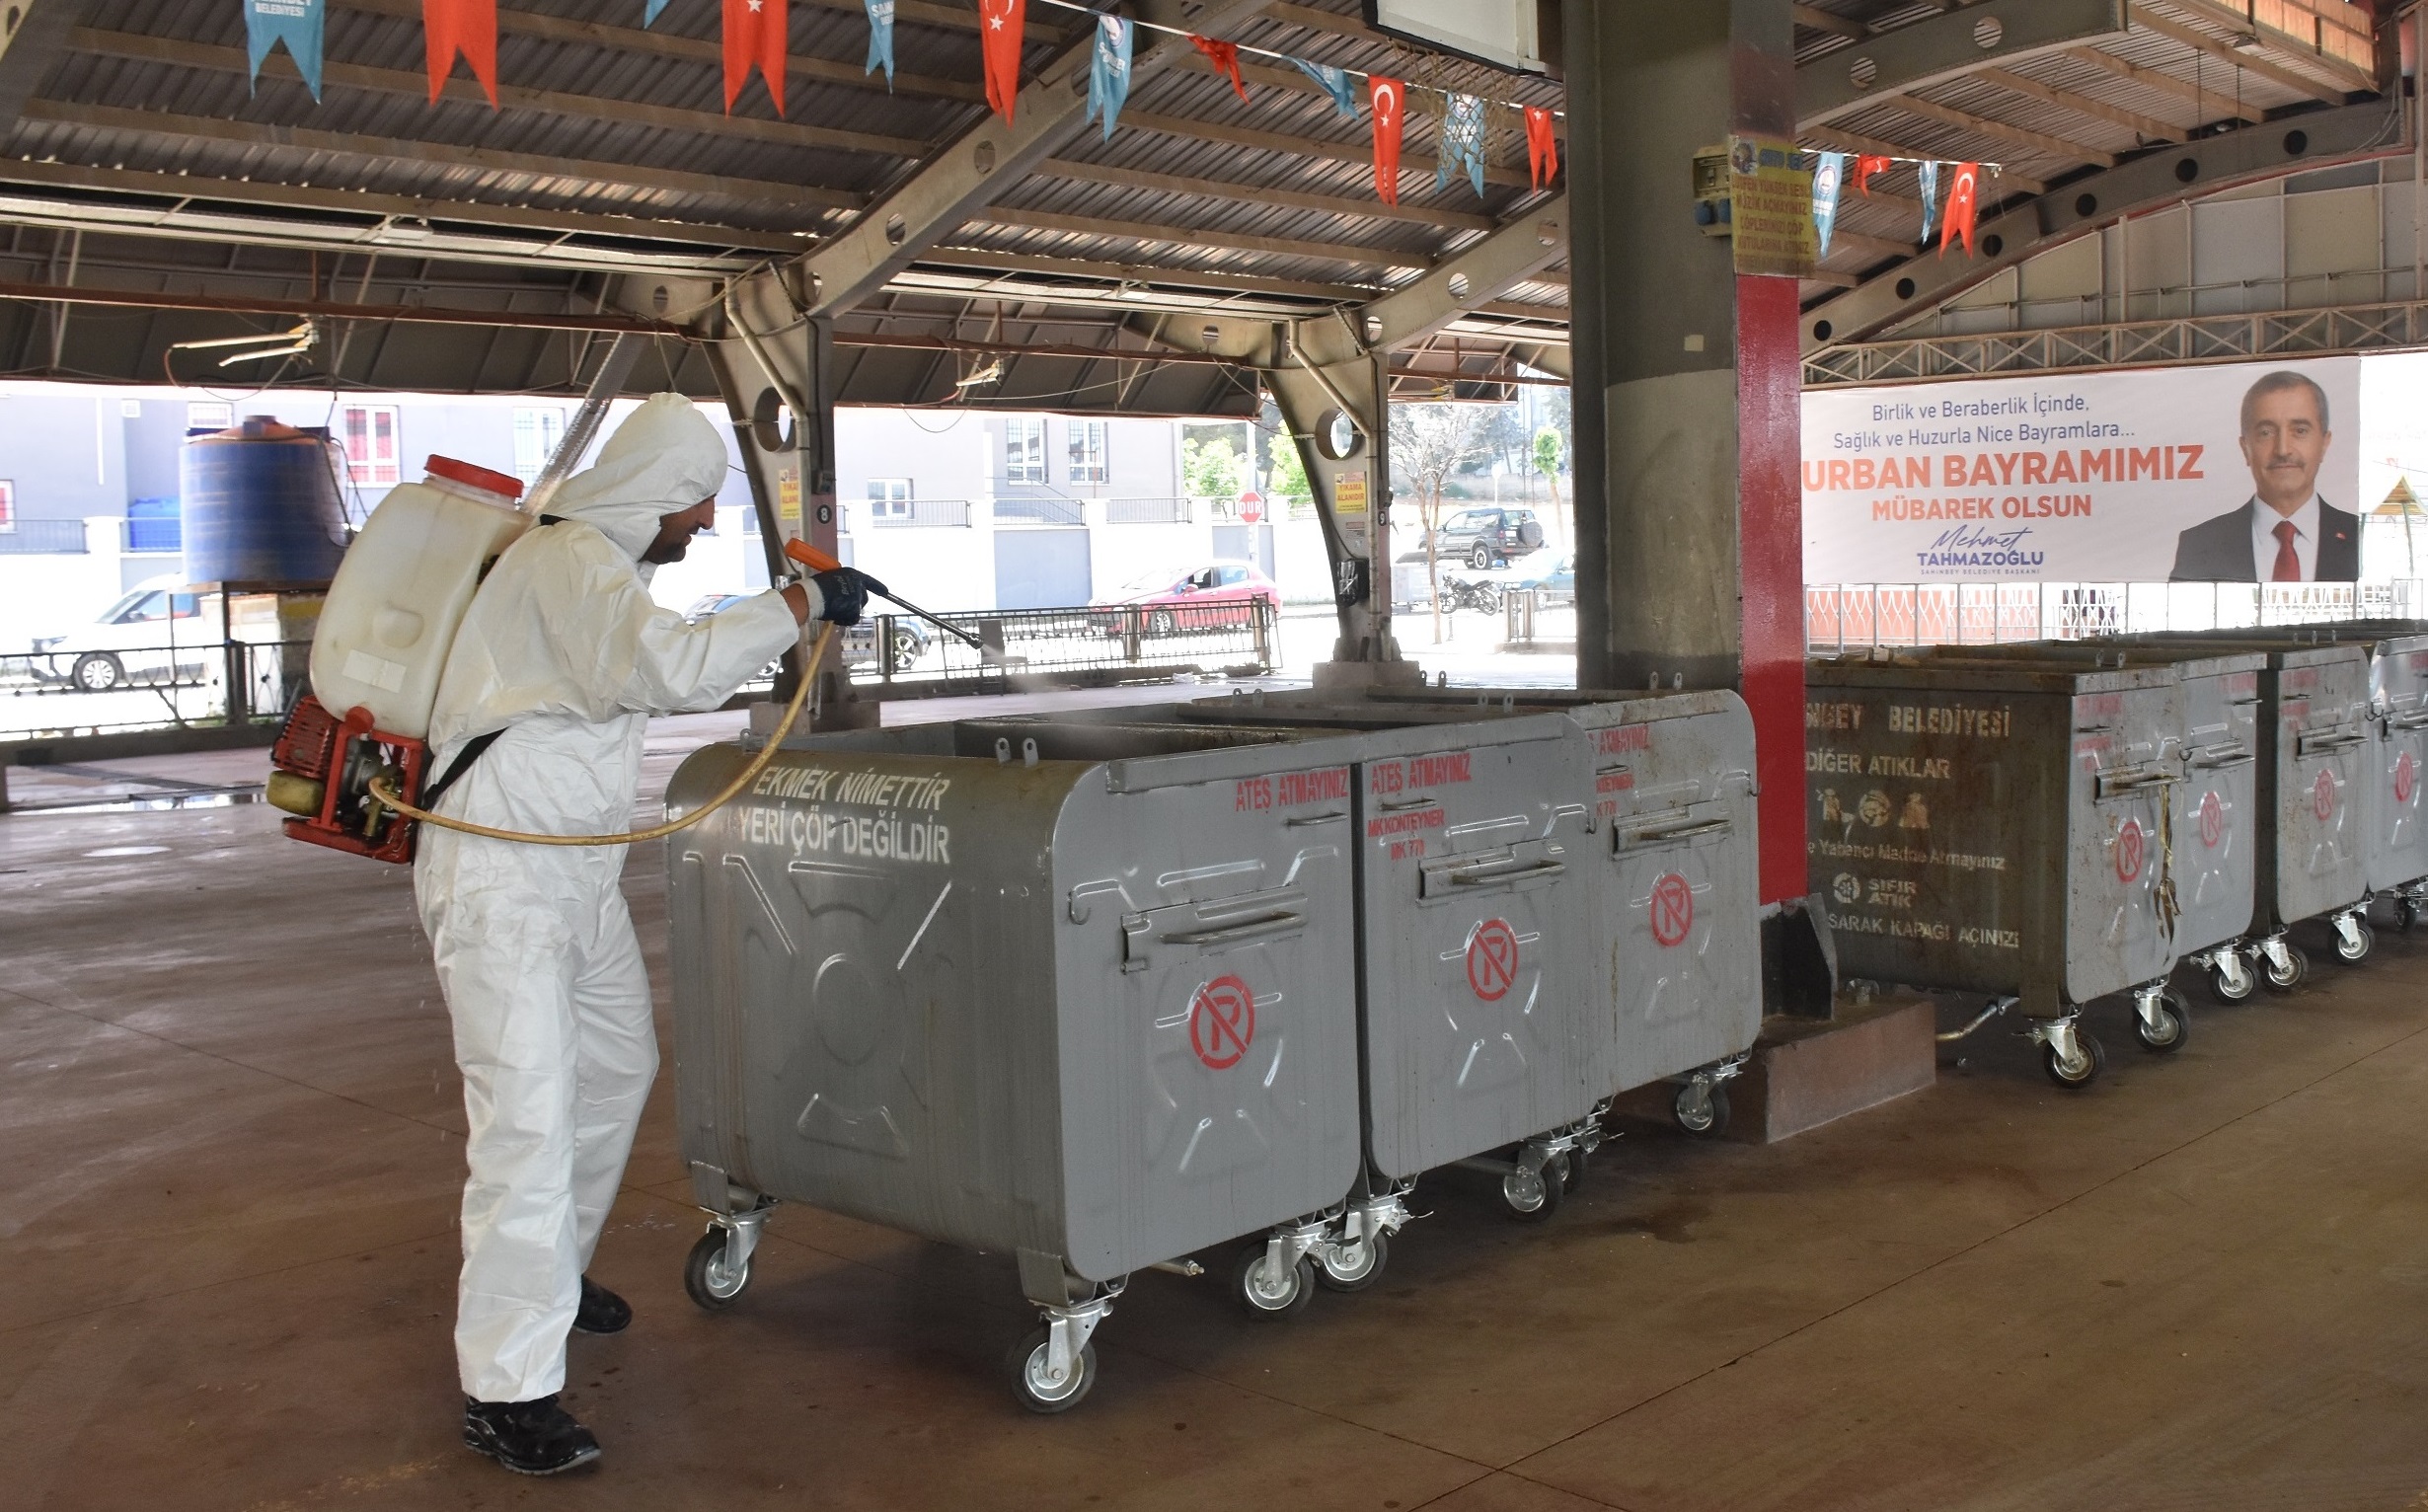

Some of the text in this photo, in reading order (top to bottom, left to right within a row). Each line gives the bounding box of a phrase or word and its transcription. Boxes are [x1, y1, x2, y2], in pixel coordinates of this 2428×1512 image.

[1872, 403, 1914, 421] Birlik
[1920, 406, 1936, 419] ve
[1942, 397, 2028, 418] Beraberlik
[1834, 430, 1881, 452] Sağlık
[1886, 432, 1903, 447] ve
[1909, 425, 1972, 446] Huzurla
[1977, 424, 2013, 444] Nice
[1802, 444, 2204, 491] URBAN BAYRAMIMIZ
[820, 507, 828, 521] 8
[1239, 500, 1262, 514] DUR
[1379, 512, 1386, 524] 9
[1871, 494, 2090, 521] MÜBAREK OLSUN
[1931, 524, 2033, 552] Mehmet
[1917, 550, 2044, 567] TAHMAZOĞLU
[1888, 703, 2011, 737] BELEDİYESİ
[1408, 752, 1472, 790] ATMAYINIZ
[1805, 747, 1951, 779] DİĞER ATIKLAR
[752, 766, 951, 811] EKMEK NİMETTİR
[1278, 767, 1349, 807] ATMAYINIZ
[738, 800, 951, 865] YERİ ÇÖP DEĞİLDİR
[1828, 913, 1884, 936] SARAK
